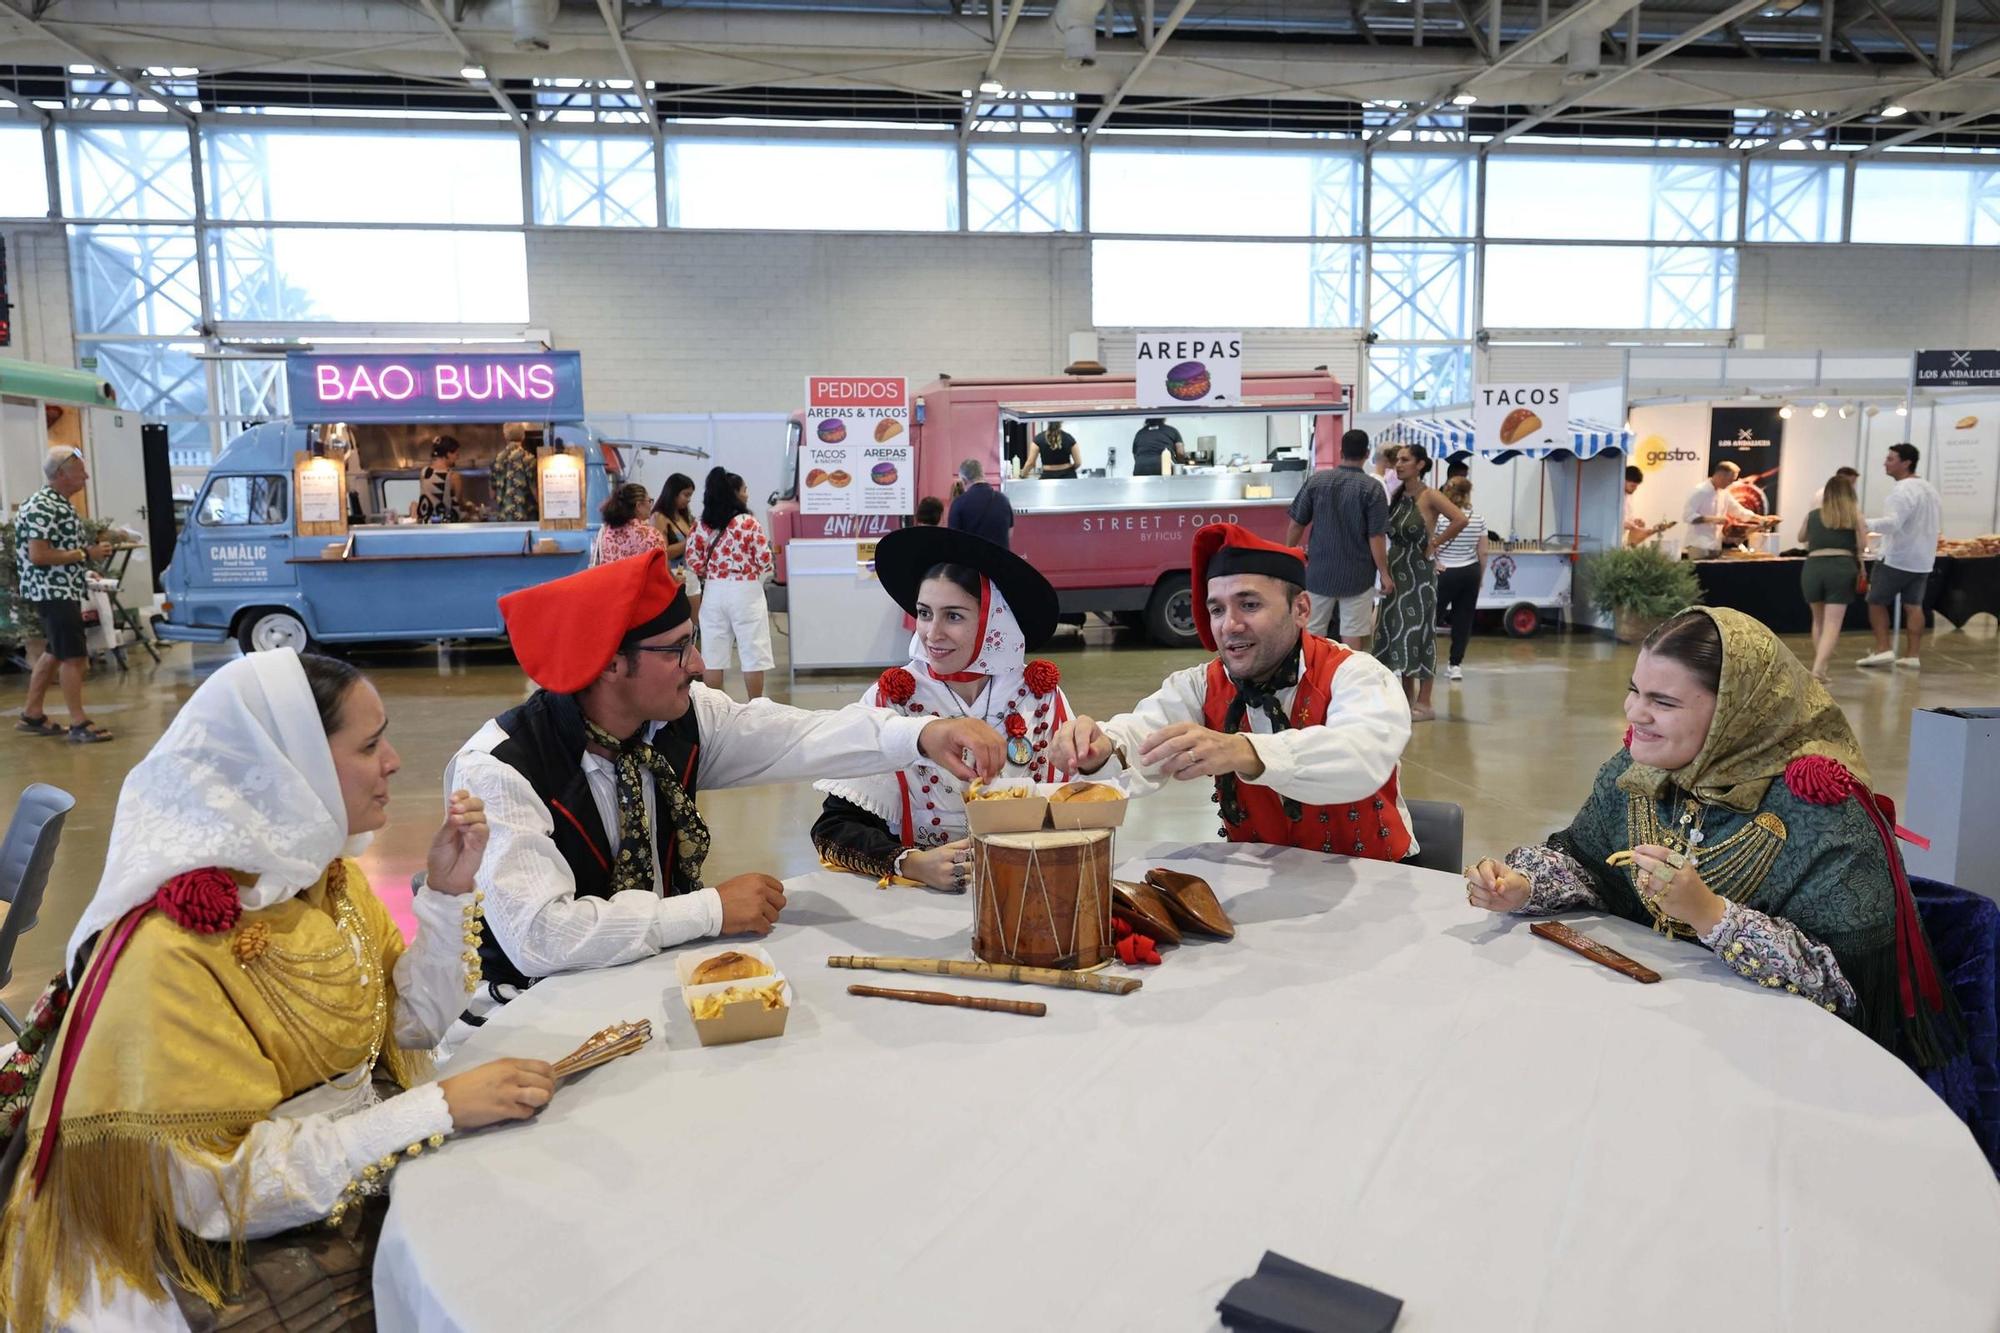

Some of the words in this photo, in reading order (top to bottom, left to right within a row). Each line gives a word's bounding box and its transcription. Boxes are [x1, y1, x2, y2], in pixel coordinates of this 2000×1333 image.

[1138, 341, 1240, 359] AREPAS
[316, 364, 414, 400] BAO
[435, 364, 554, 400] BUNS
[1919, 369, 1938, 379] LOS
[817, 382, 898, 399] PEDIDOS
[1483, 388, 1559, 406] TACOS
[807, 408, 854, 418] AREPAS
[856, 408, 865, 418] &
[869, 408, 907, 418] TACOS
[810, 449, 846, 459] TACOS
[864, 448, 907, 457] AREPAS
[1646, 447, 1700, 465] gastro.
[1083, 515, 1162, 531] STREET
[1178, 514, 1239, 527] FOOD
[1140, 533, 1151, 542] BY
[1155, 532, 1182, 541] FICUS
[210, 543, 267, 560] CAMÀLIC
